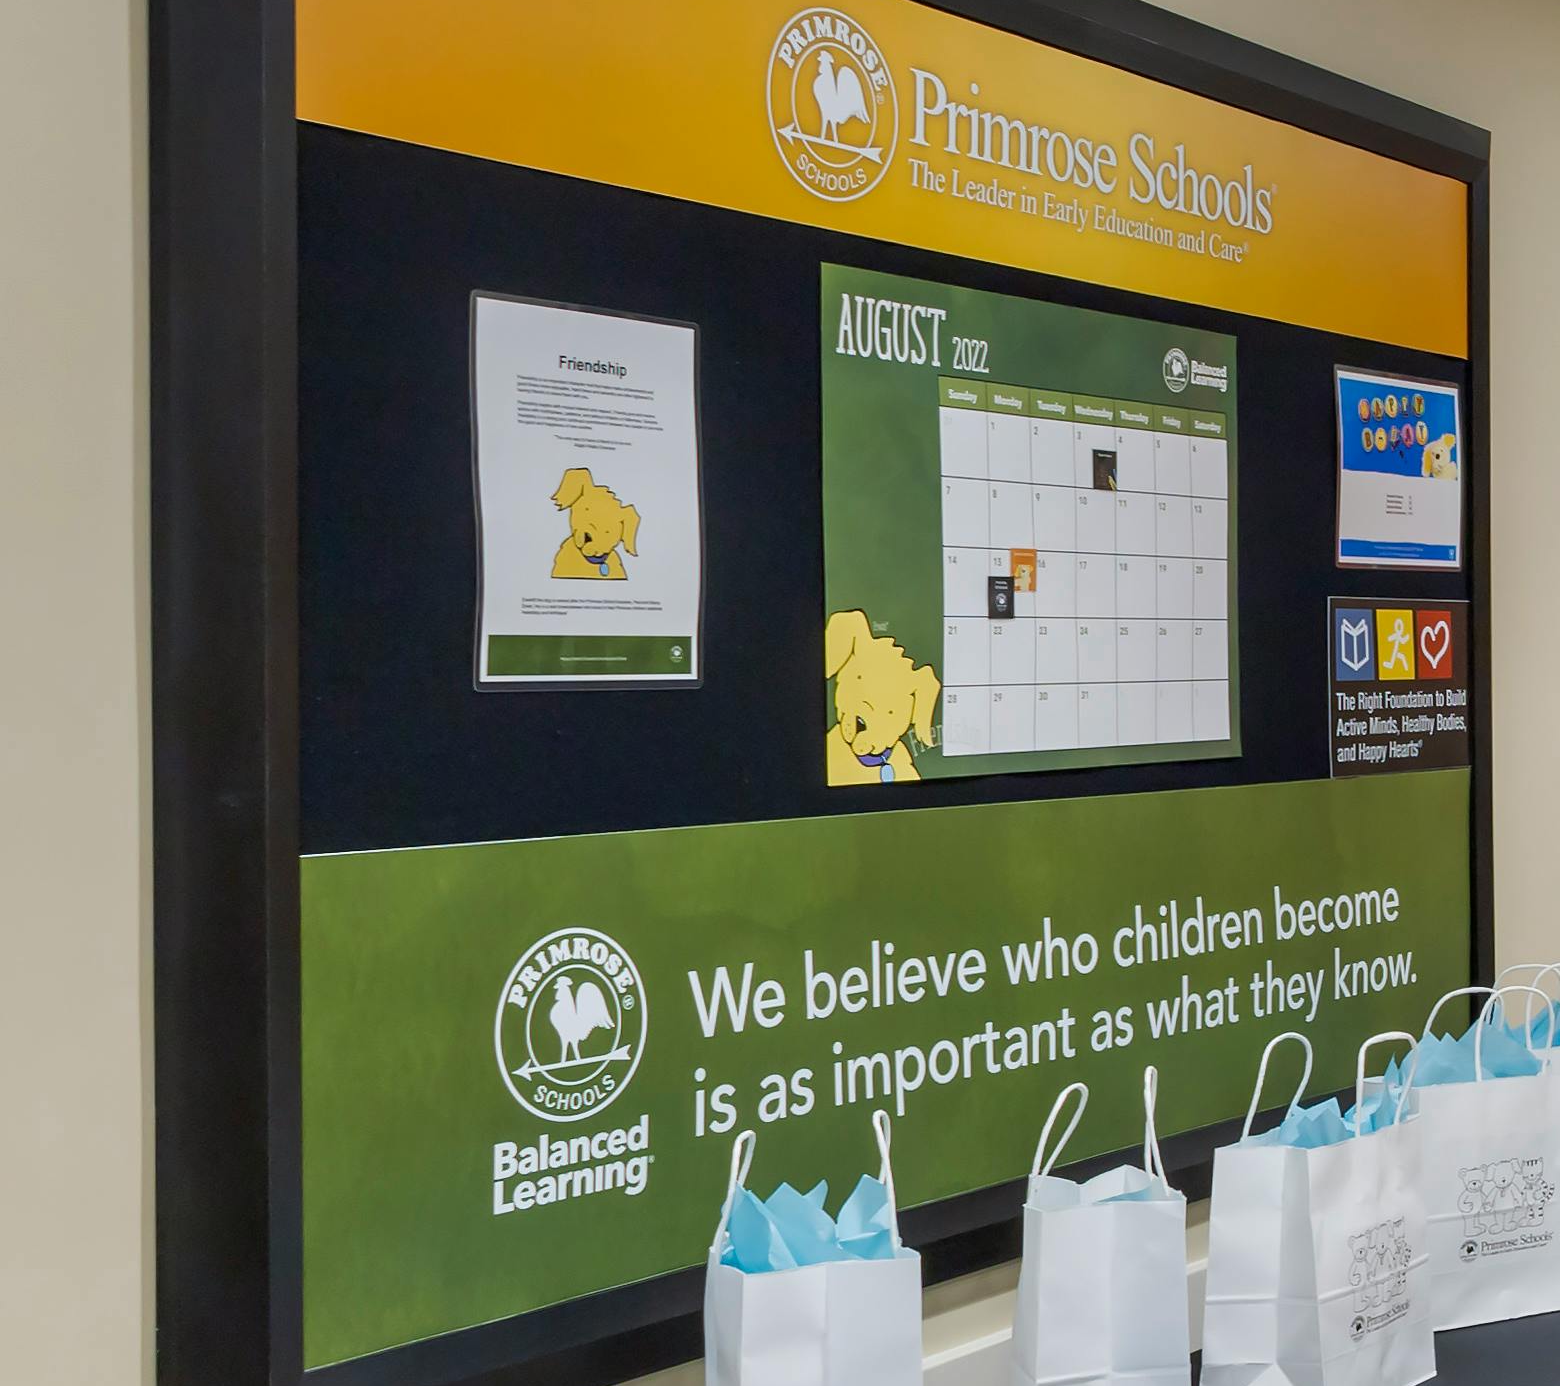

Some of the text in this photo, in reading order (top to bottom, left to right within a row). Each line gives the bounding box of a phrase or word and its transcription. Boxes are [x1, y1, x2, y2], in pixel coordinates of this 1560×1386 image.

[777, 16, 887, 92] PRIMROSE
[797, 154, 867, 192] SCHOOLS
[908, 67, 1274, 235] Primrose Schools
[908, 158, 945, 193] The
[951, 168, 1016, 212] Leader
[1020, 185, 1038, 215] in
[1043, 191, 1088, 233] Early
[1092, 205, 1173, 248] Education
[1177, 223, 1205, 254] and
[836, 292, 990, 373] AUGUST 2022
[558, 355, 627, 379] Friendship
[948, 388, 1221, 434] Sunday Monday Tuesday Wednesday Thursday Friday Saturday
[1336, 689, 1467, 714] The Right Foundation to Build
[1336, 713, 1467, 737] Active Minds, Healthy Bodies,
[1337, 743, 1356, 763] and
[1358, 743, 1388, 763] Happy
[507, 936, 635, 1011] PRIMROSE
[687, 884, 1400, 1040] We believe who children become
[694, 946, 1418, 1138] is as important as what they know.
[533, 1073, 617, 1112] SCHOOLS
[493, 1114, 649, 1183] Balanced
[493, 1155, 649, 1216] Learning
